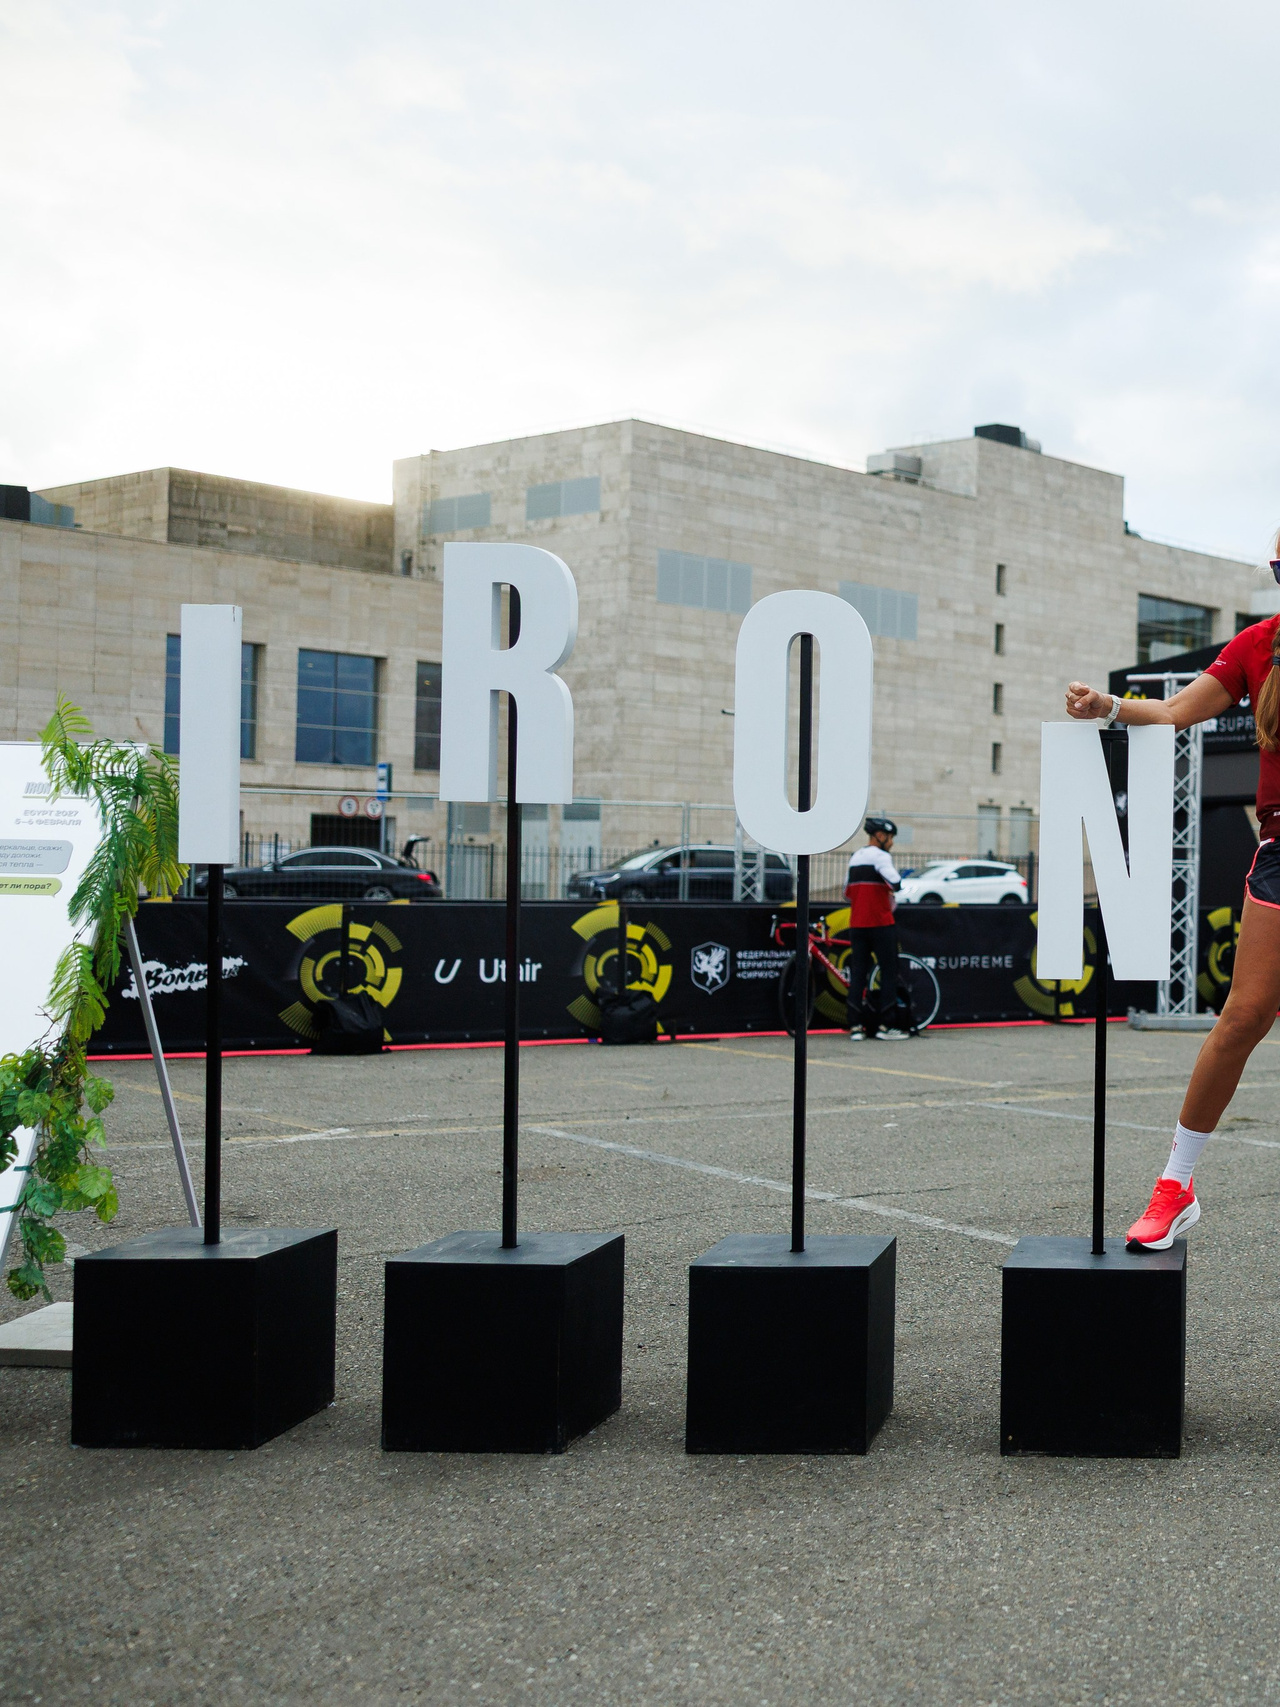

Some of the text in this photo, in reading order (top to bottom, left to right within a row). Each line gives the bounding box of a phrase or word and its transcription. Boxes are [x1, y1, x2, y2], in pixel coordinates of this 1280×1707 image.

[35, 818, 82, 826] ФЕВРАЛЯ
[23, 883, 52, 891] пора?
[938, 955, 1014, 969] SUPREME
[478, 957, 542, 984] Utir
